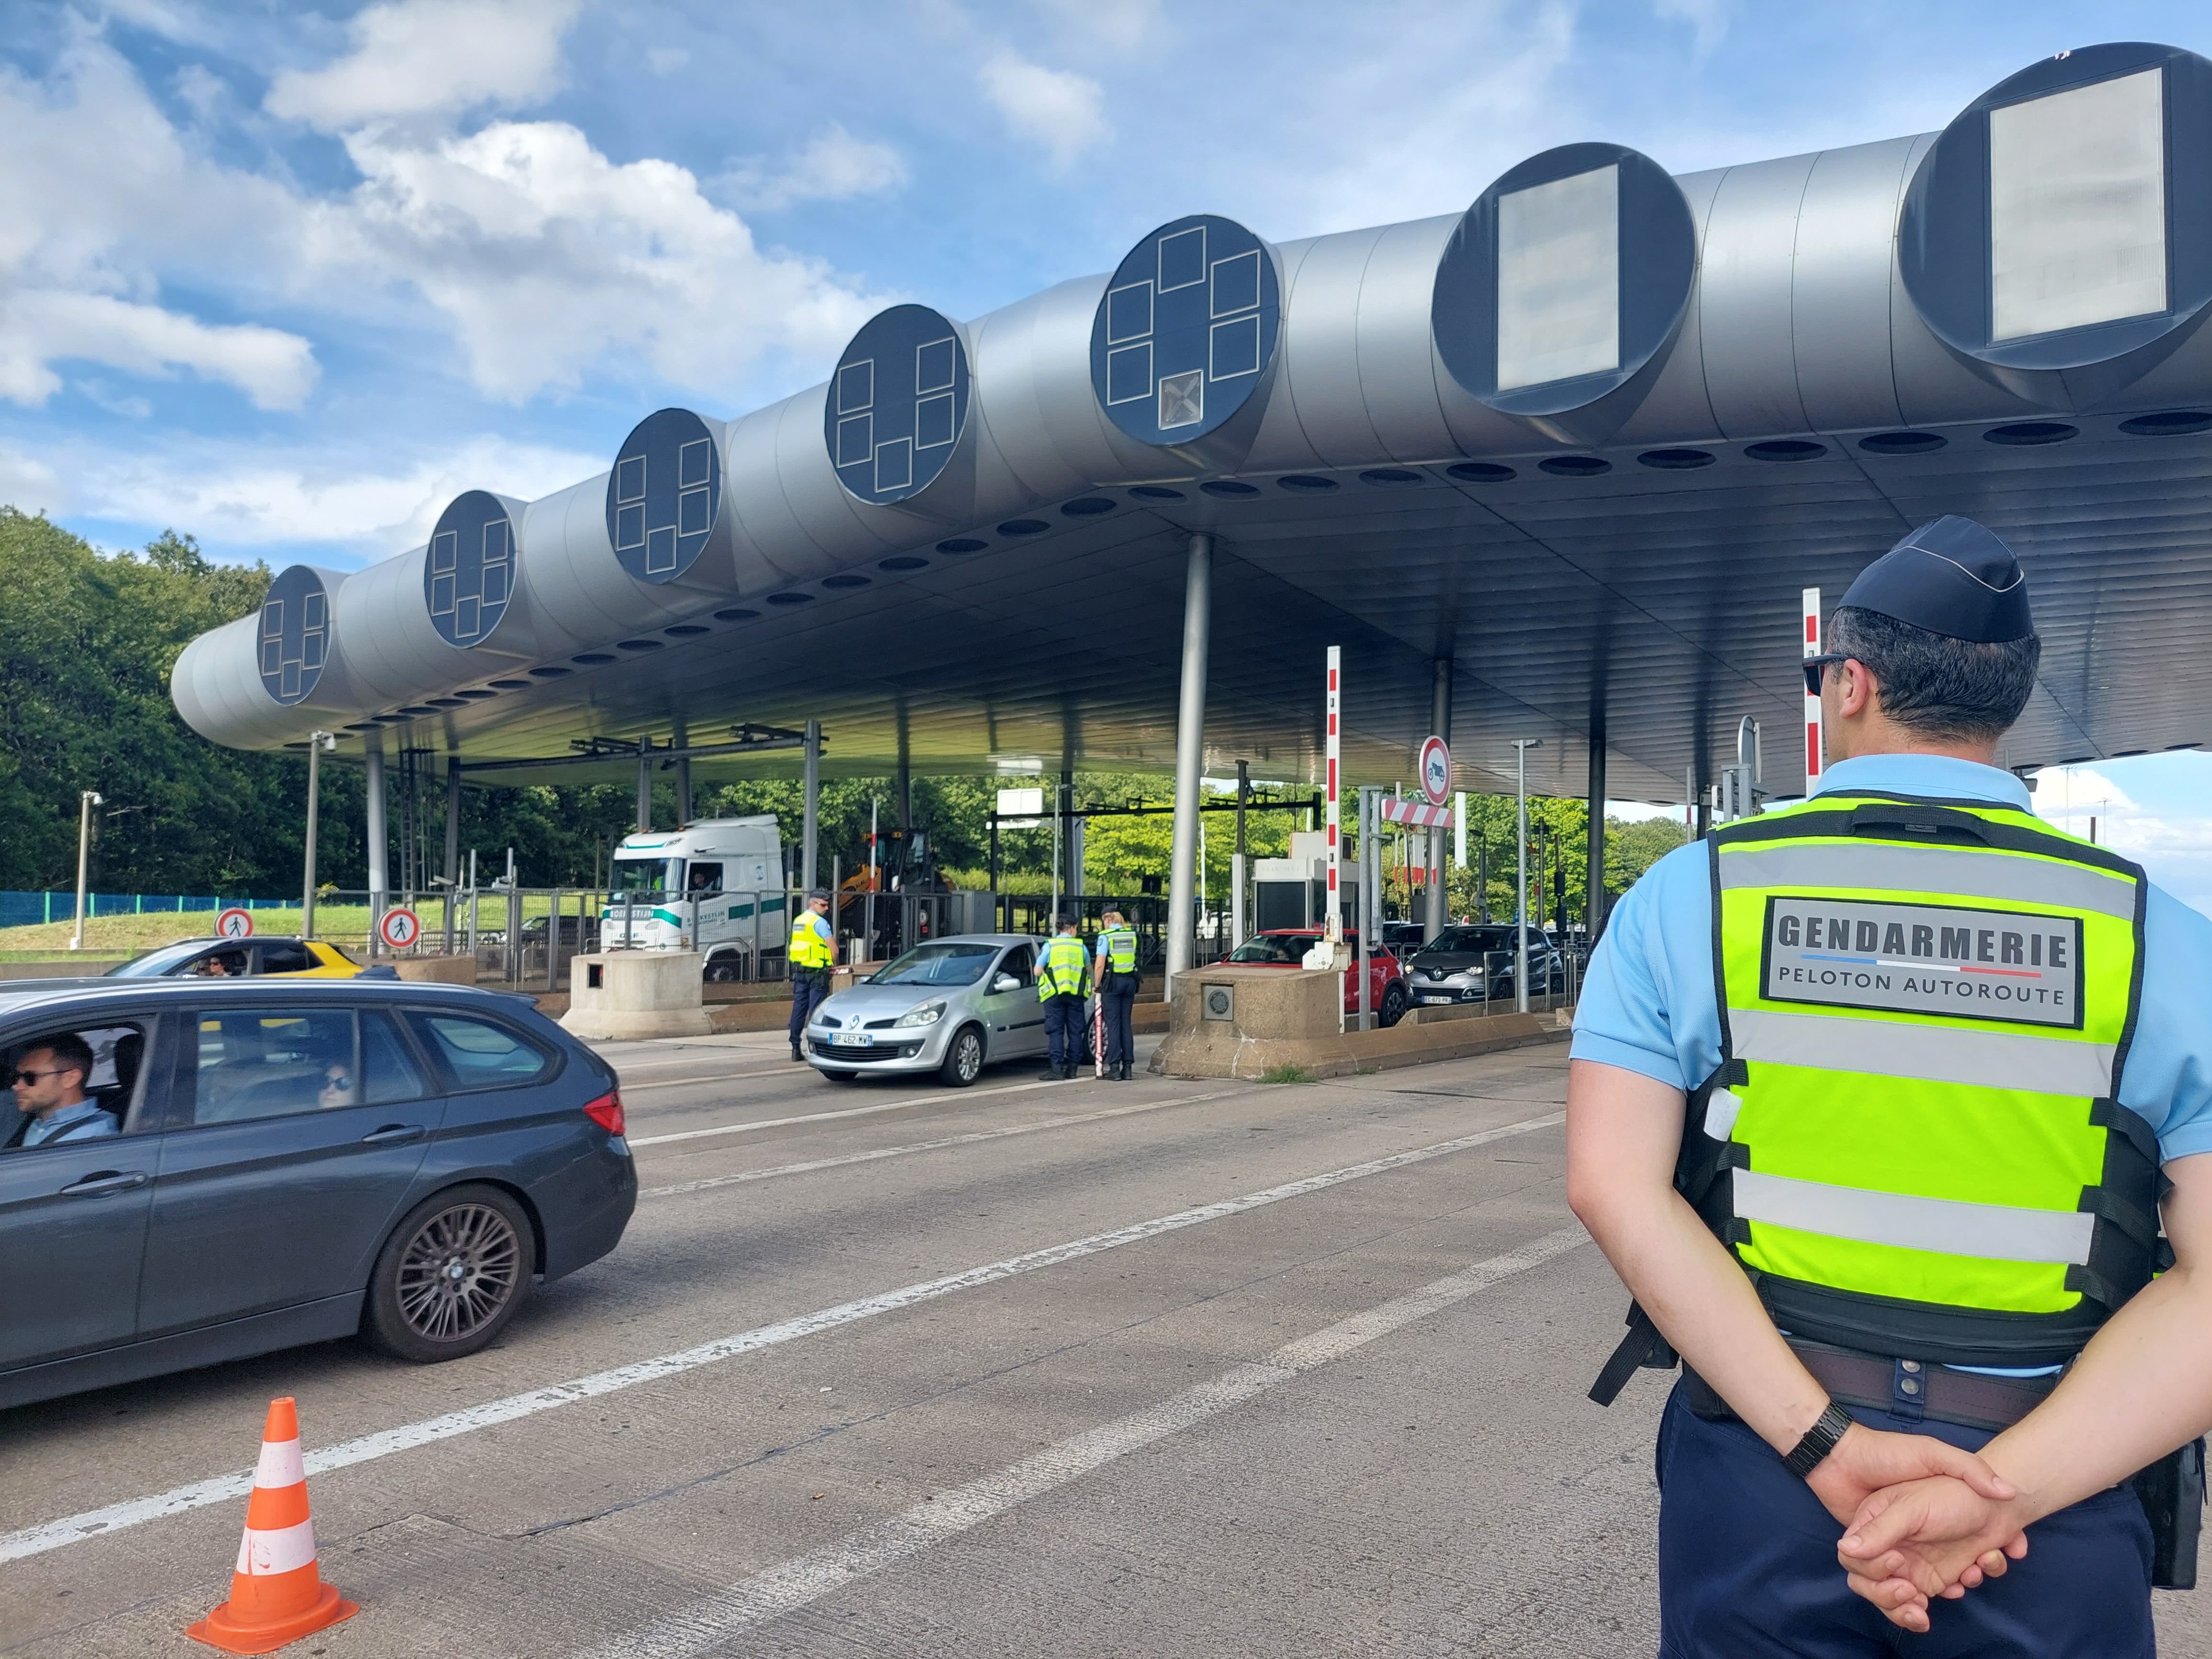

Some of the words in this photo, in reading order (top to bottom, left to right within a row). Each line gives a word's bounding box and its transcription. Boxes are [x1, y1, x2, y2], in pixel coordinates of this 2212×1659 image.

[1778, 915, 2067, 969] GENDARMERIE
[1779, 967, 1891, 990] PELOTON
[1903, 978, 2065, 1005] AUTOROUTE
